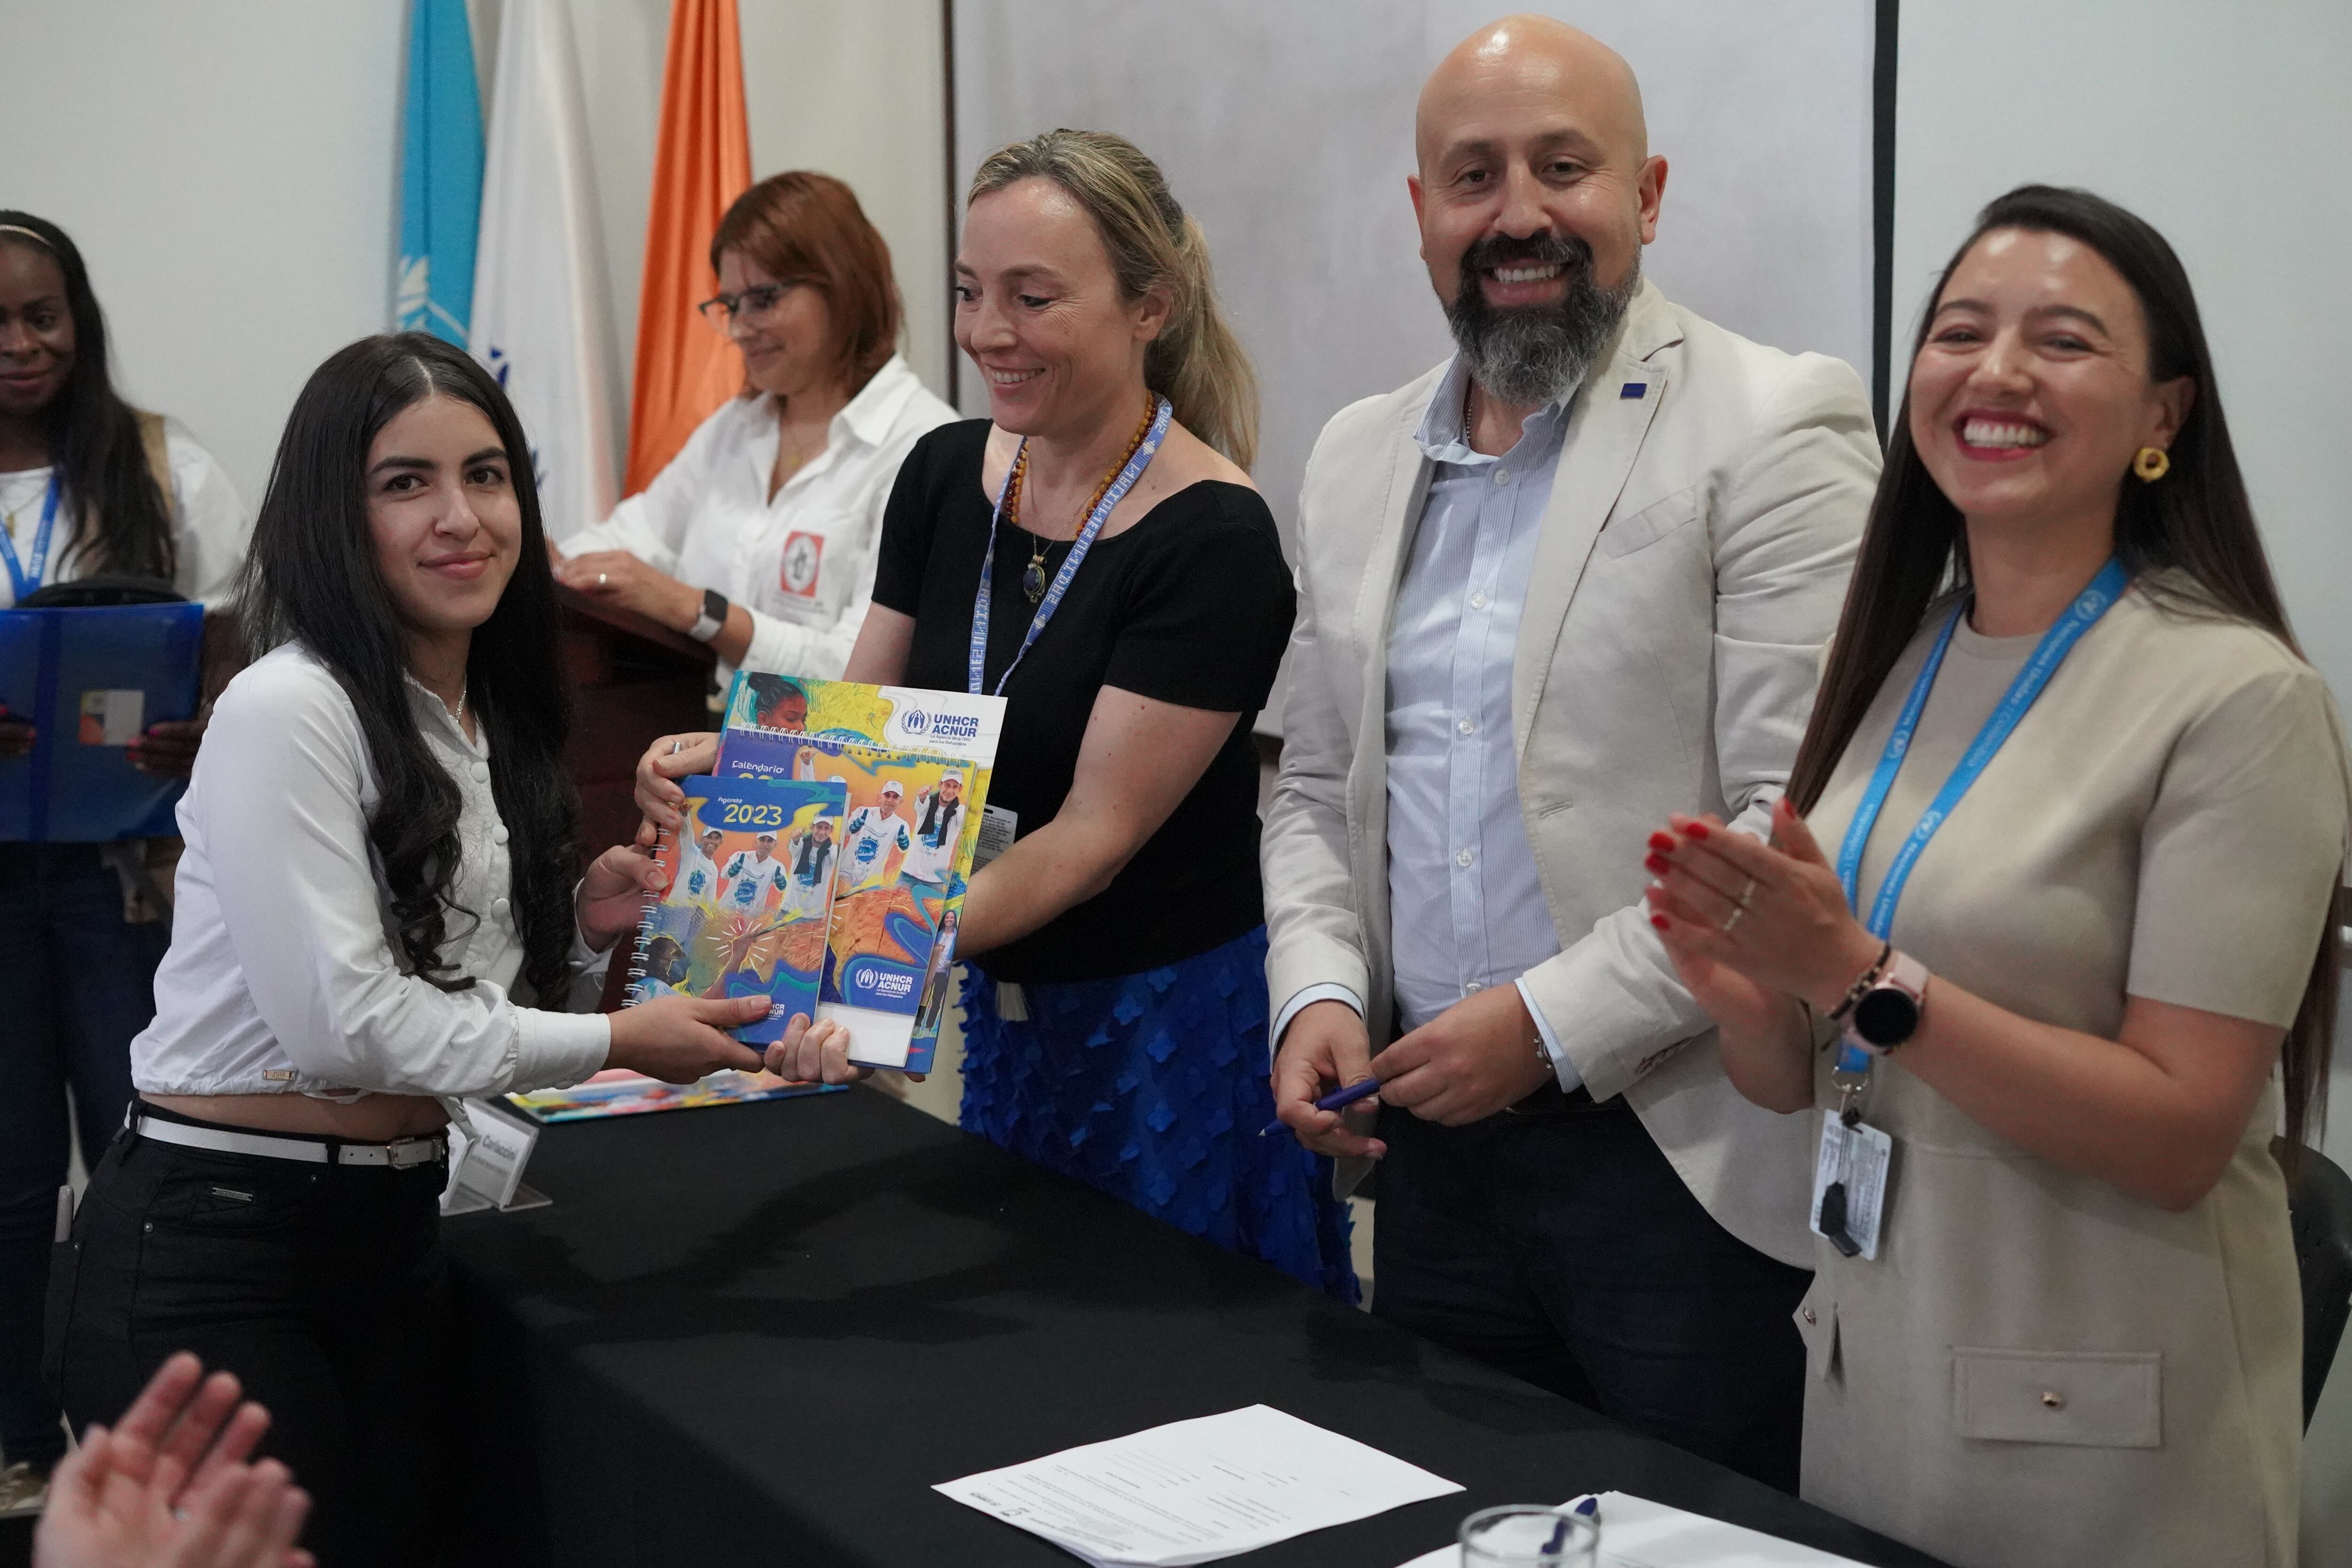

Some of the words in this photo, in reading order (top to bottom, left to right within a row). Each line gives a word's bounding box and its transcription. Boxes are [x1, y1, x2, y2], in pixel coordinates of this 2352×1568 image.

[934, 714, 979, 727] UNHCR
[932, 724, 977, 737] ACNUR
[732, 760, 784, 774] Calendario
[723, 804, 782, 826] 2023
[879, 972, 913, 985] UNHCR
[877, 981, 911, 992] ACNUR
